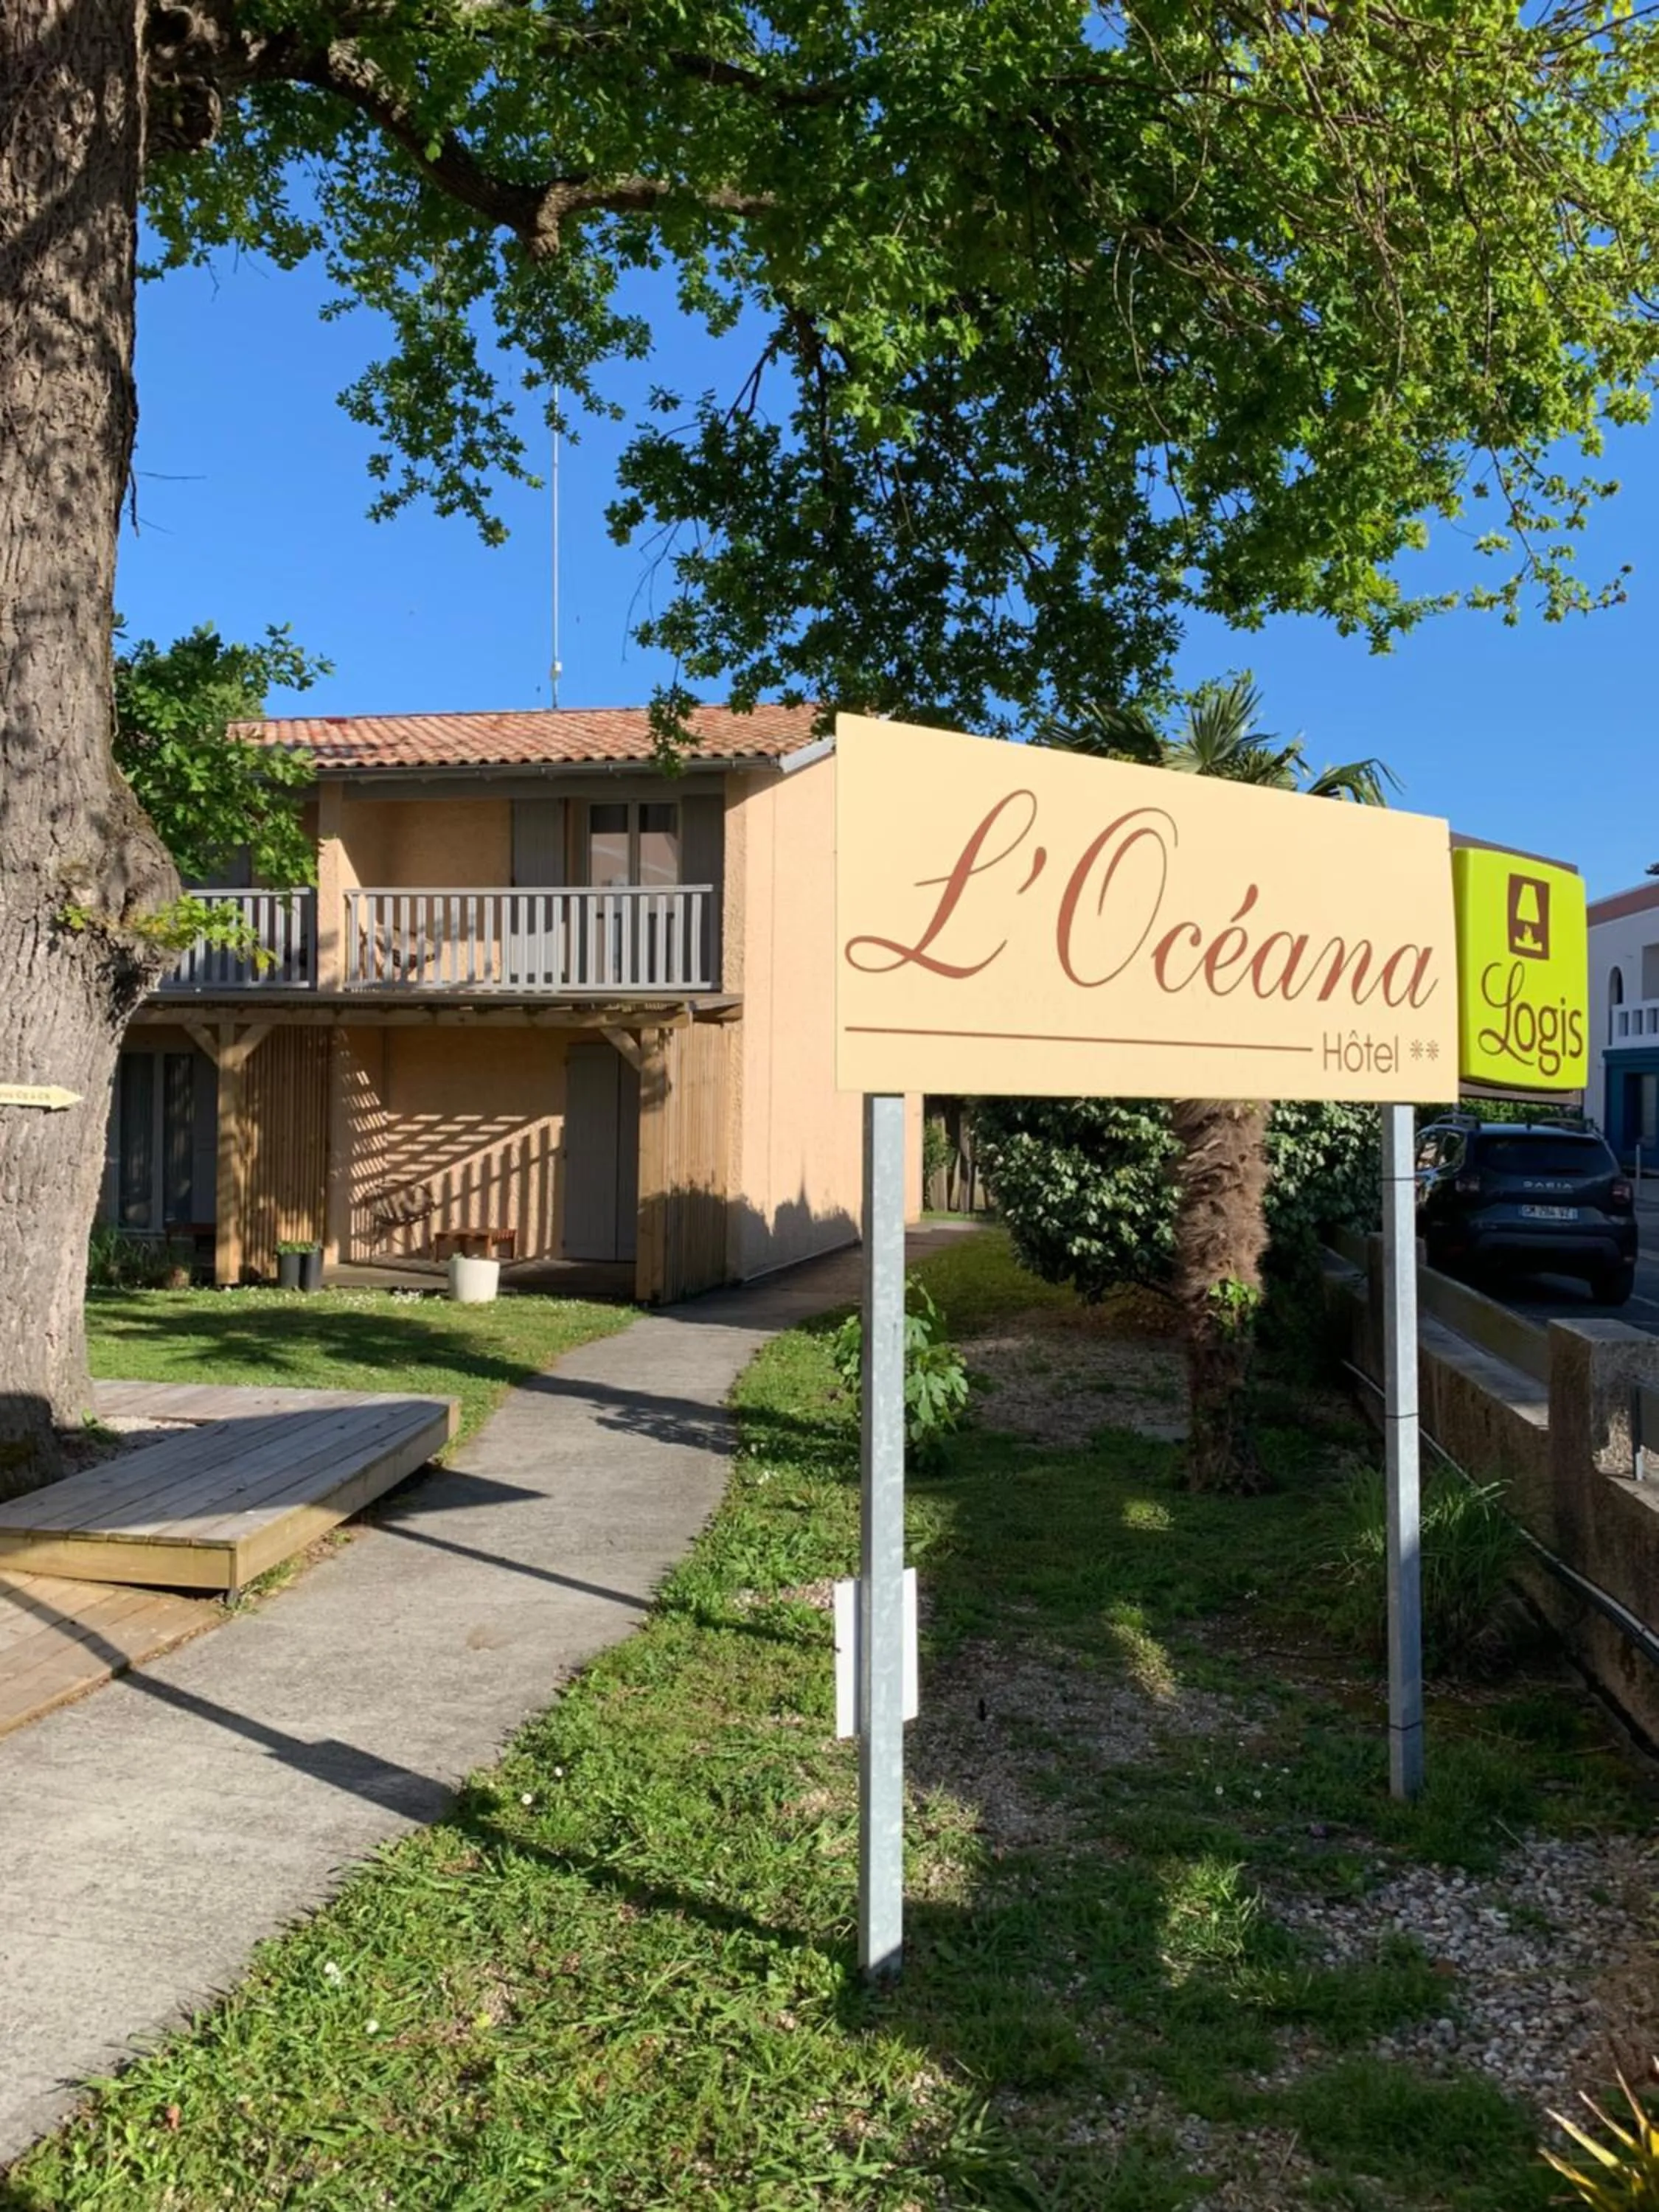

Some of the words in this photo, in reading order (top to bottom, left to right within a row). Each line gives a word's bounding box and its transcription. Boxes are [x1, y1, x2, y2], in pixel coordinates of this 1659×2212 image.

[844, 789, 1439, 1009] L'Océana
[1323, 1030, 1399, 1074] Hôtel
[1478, 961, 1583, 1077] Logis
